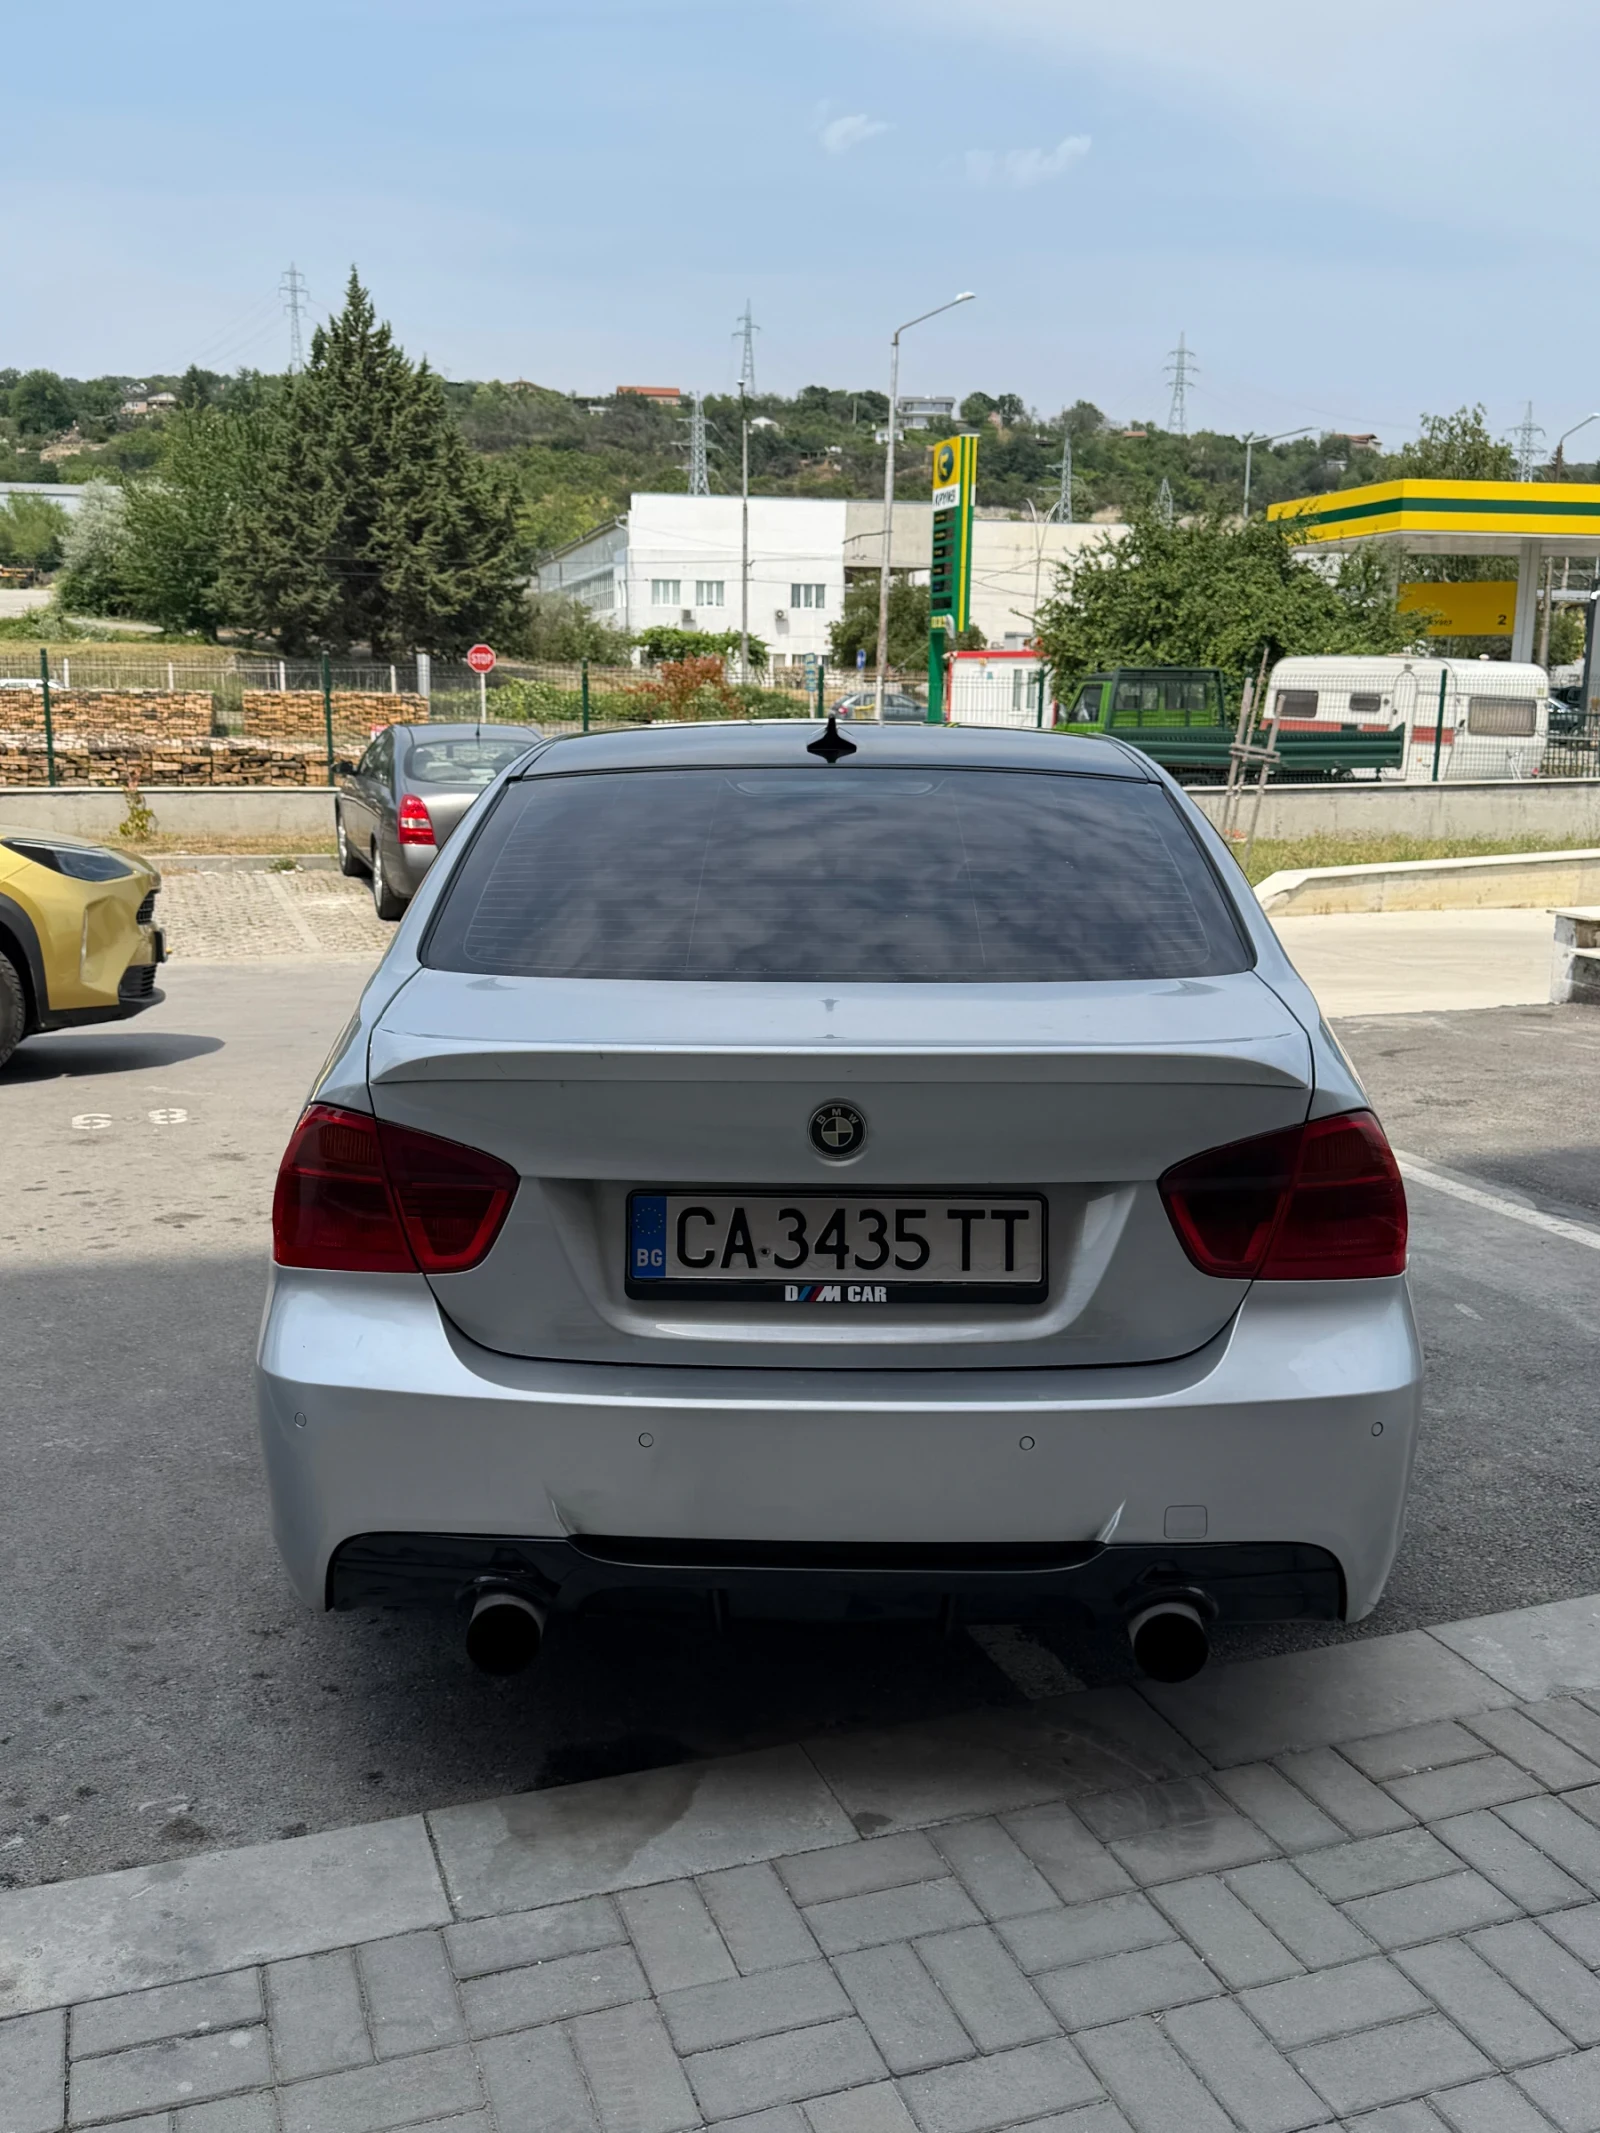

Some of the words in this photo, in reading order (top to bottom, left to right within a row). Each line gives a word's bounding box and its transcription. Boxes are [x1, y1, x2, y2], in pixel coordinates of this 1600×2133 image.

[1497, 614, 1507, 625] 2
[471, 653, 492, 665] STOP
[816, 1107, 859, 1125] BMW
[676, 1206, 758, 1269] CA
[773, 1207, 931, 1271] 3435
[947, 1208, 1030, 1272] TT
[637, 1249, 663, 1267] BG
[847, 1285, 887, 1303] CAR
